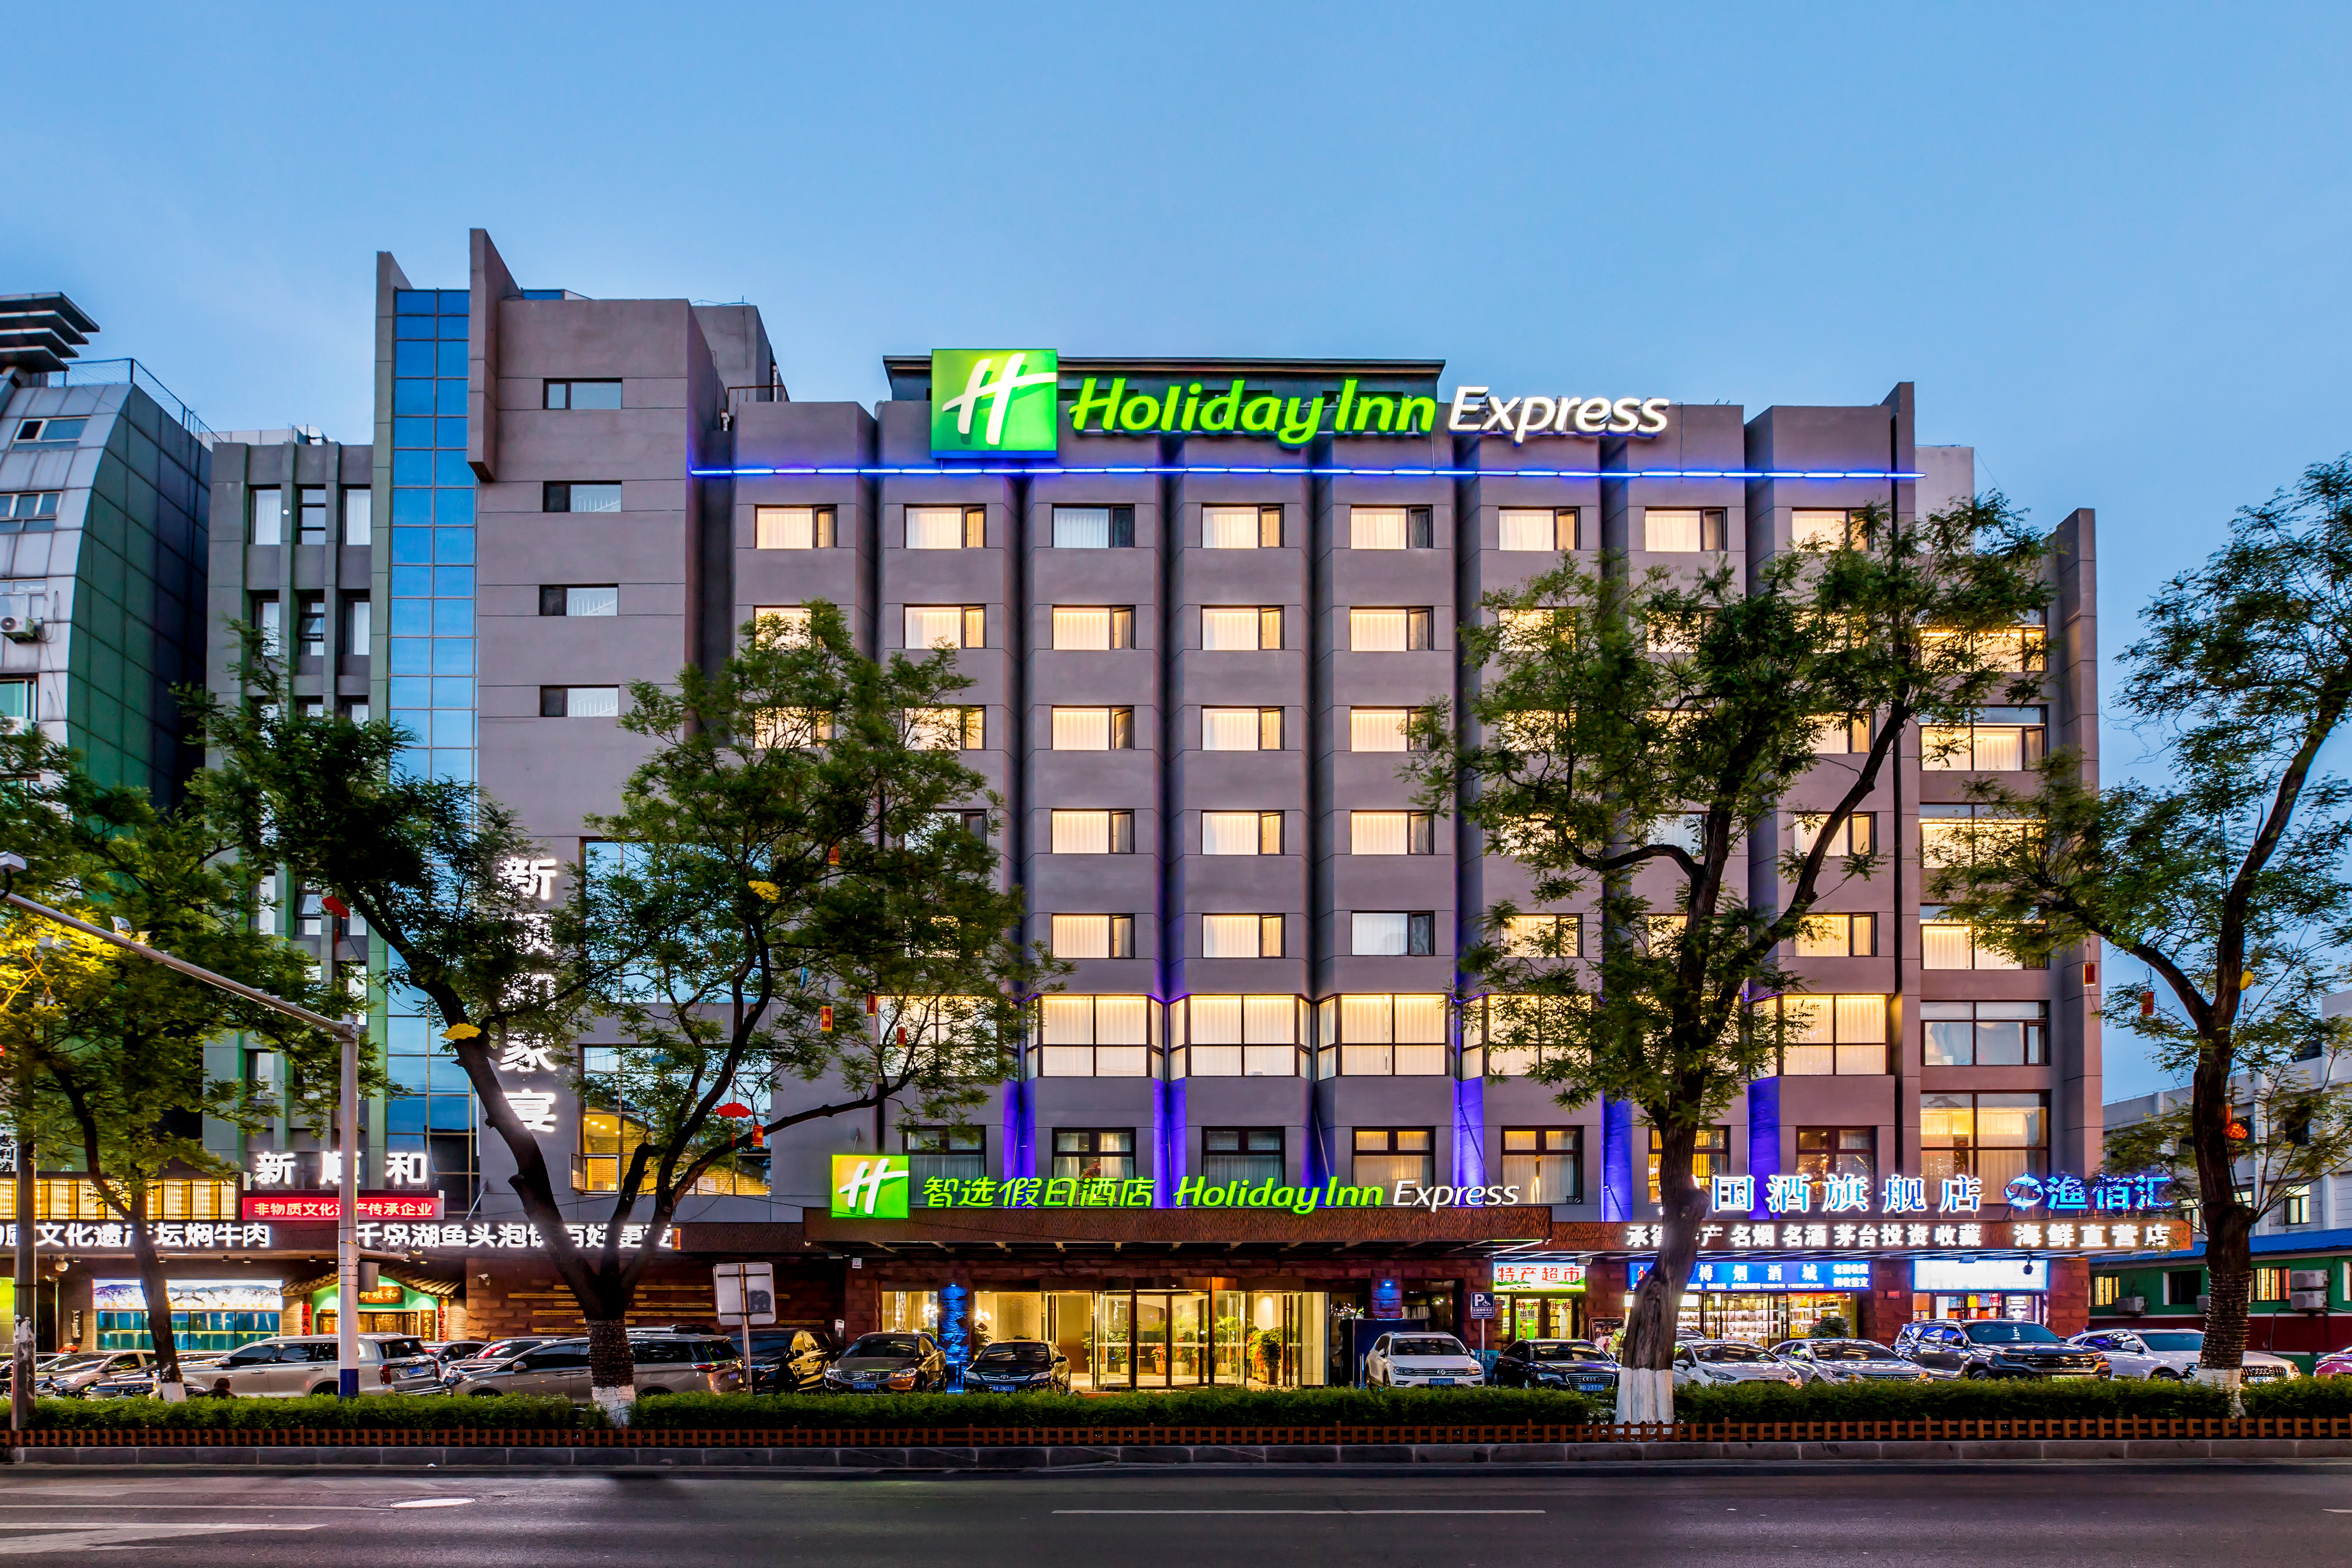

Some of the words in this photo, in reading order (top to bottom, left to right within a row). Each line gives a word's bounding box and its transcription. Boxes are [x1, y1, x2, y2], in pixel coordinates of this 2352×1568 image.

[1069, 378, 1324, 448] Holiday
[1335, 379, 1436, 432] Inn
[1448, 386, 1671, 447] Express
[923, 1175, 1155, 1207] 智选假日酒店
[1173, 1176, 1320, 1214] Holiday
[1325, 1177, 1384, 1206] Inn
[1392, 1180, 1520, 1213] Express
[1711, 1173, 1983, 1213] 国酒旗舰店
[1782, 1224, 1827, 1248] 名酒
[2013, 1223, 2171, 1248] 海鲜直营店
[1498, 1267, 1580, 1282] 特产超市
[1474, 1294, 1485, 1306] P
[1517, 1302, 1540, 1310] 特产
